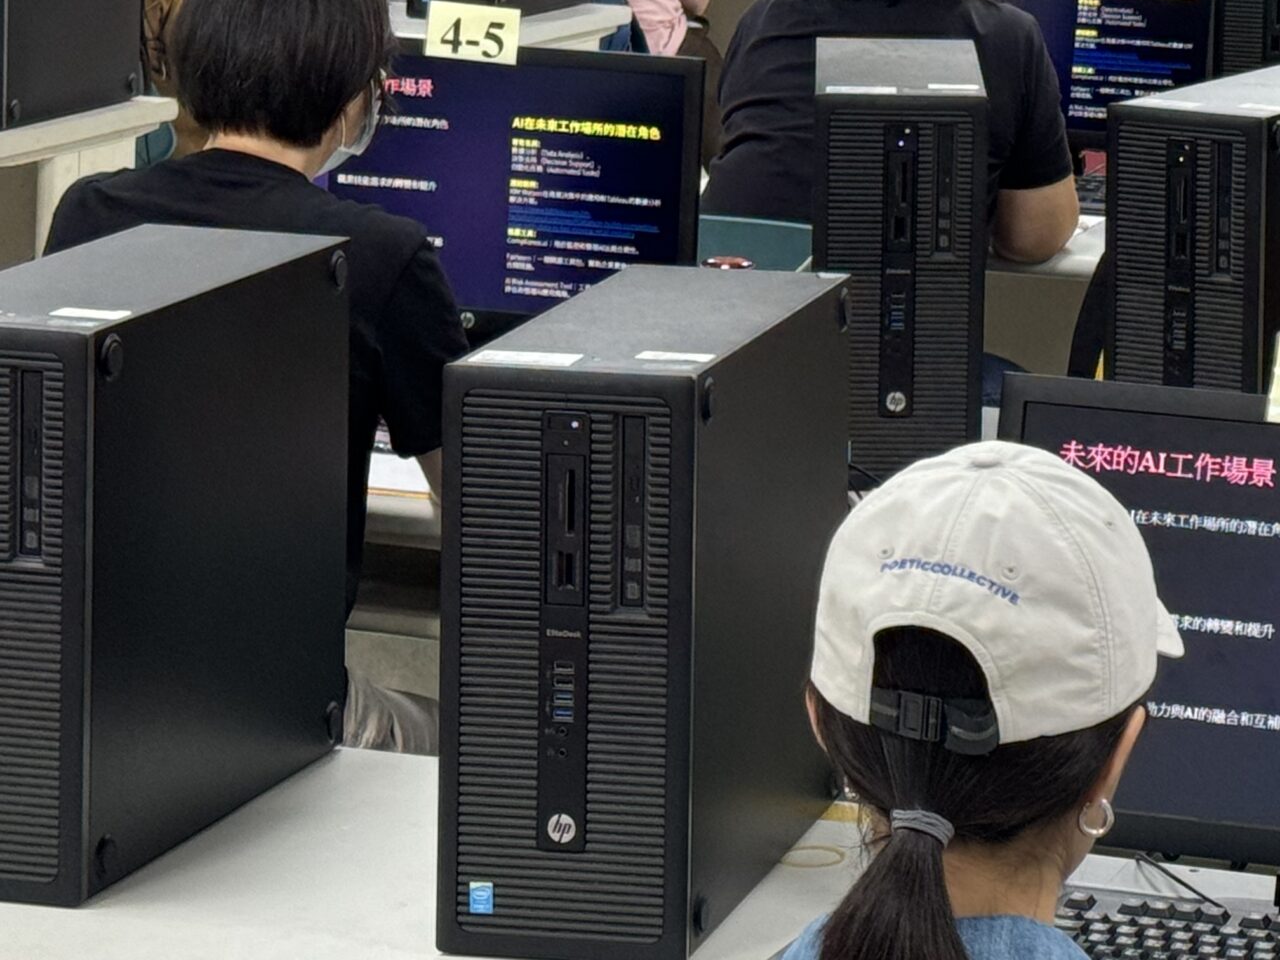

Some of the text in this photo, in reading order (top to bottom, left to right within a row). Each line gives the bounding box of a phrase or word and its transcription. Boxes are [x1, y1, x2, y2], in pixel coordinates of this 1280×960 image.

[440, 17, 507, 59] 4-5
[1059, 440, 1277, 488] 未來的AI工作場景
[547, 813, 576, 844] hp
